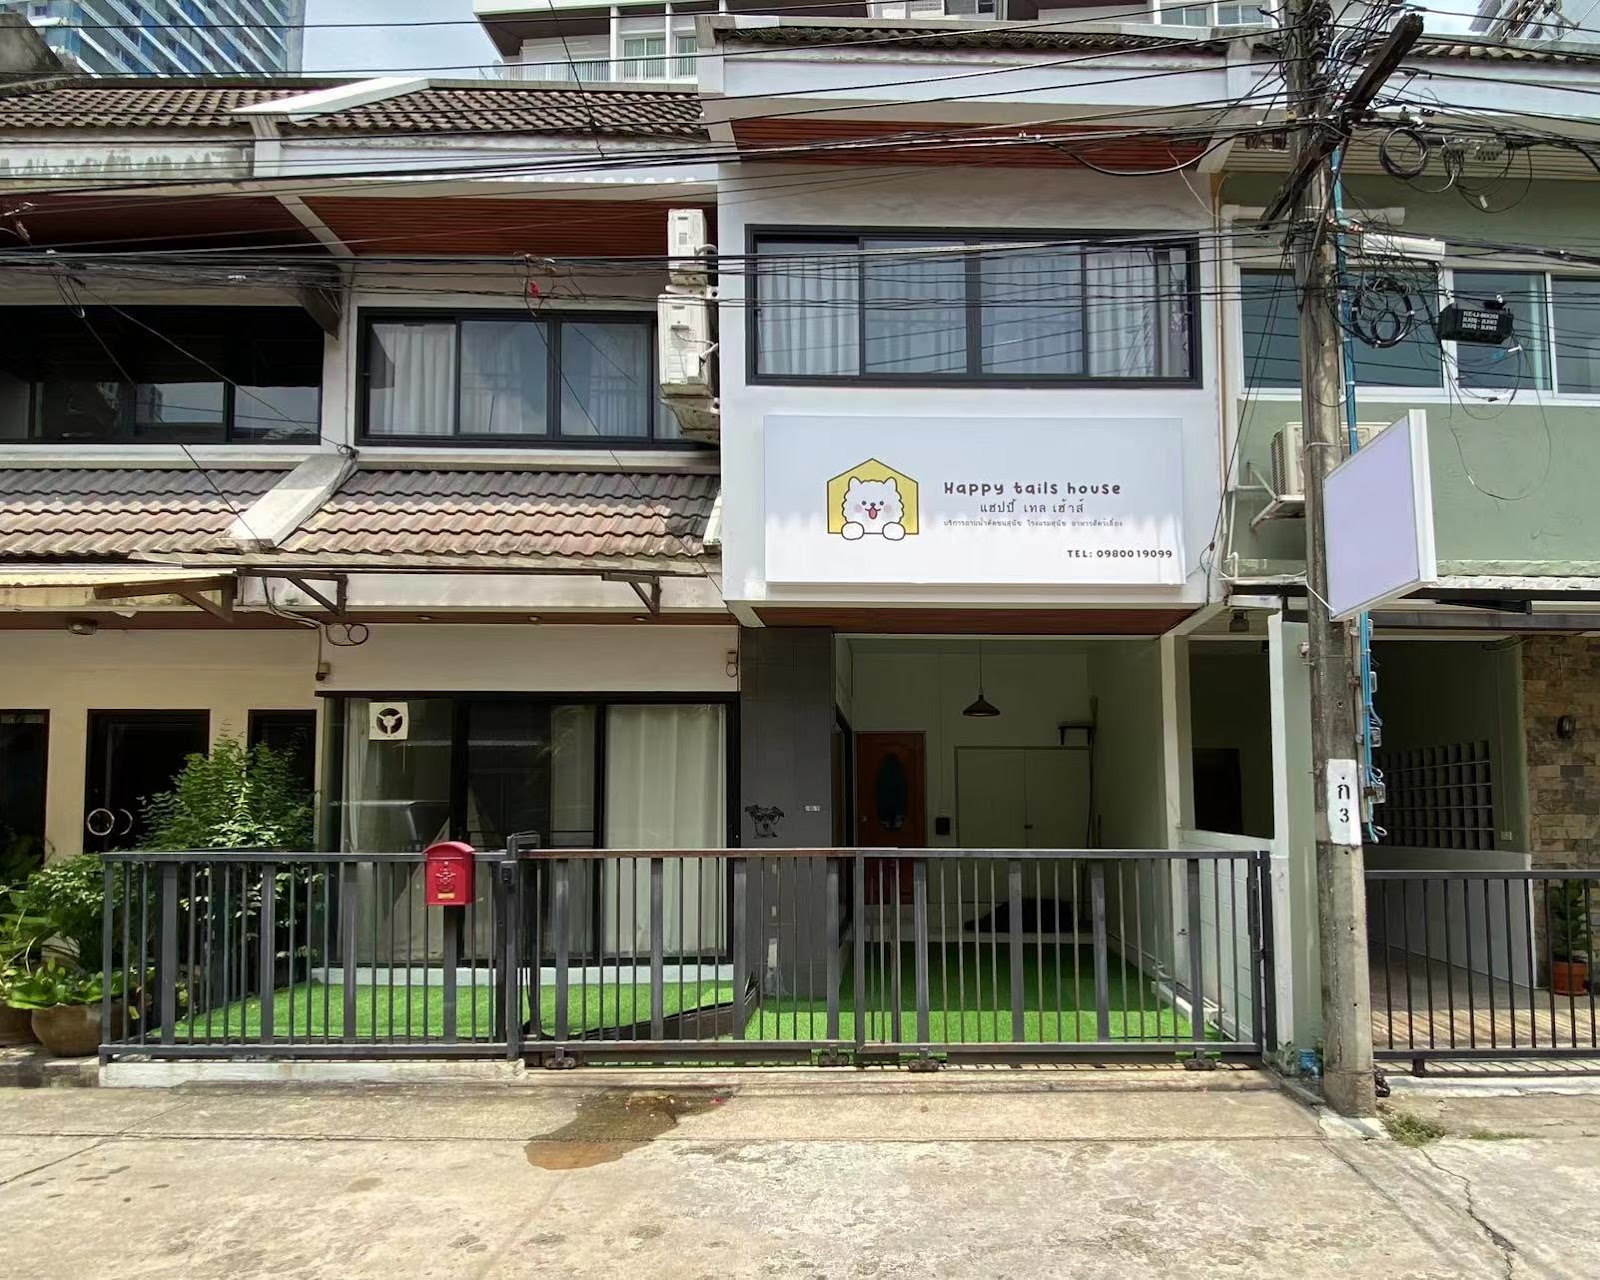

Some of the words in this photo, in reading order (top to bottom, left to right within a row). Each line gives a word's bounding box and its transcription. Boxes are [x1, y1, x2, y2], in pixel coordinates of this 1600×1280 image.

[944, 482, 1004, 496] Happy
[1014, 482, 1058, 495] tails
[1067, 482, 1121, 495] house
[980, 498, 1017, 513] แฮปปี้
[1024, 504, 1046, 513] เทล
[1053, 498, 1084, 513] เฮ้าส์
[1067, 549, 1093, 558] TEL:
[1096, 549, 1173, 558] 0980019099
[1337, 784, 1350, 799] ก
[1340, 808, 1349, 823] 3
